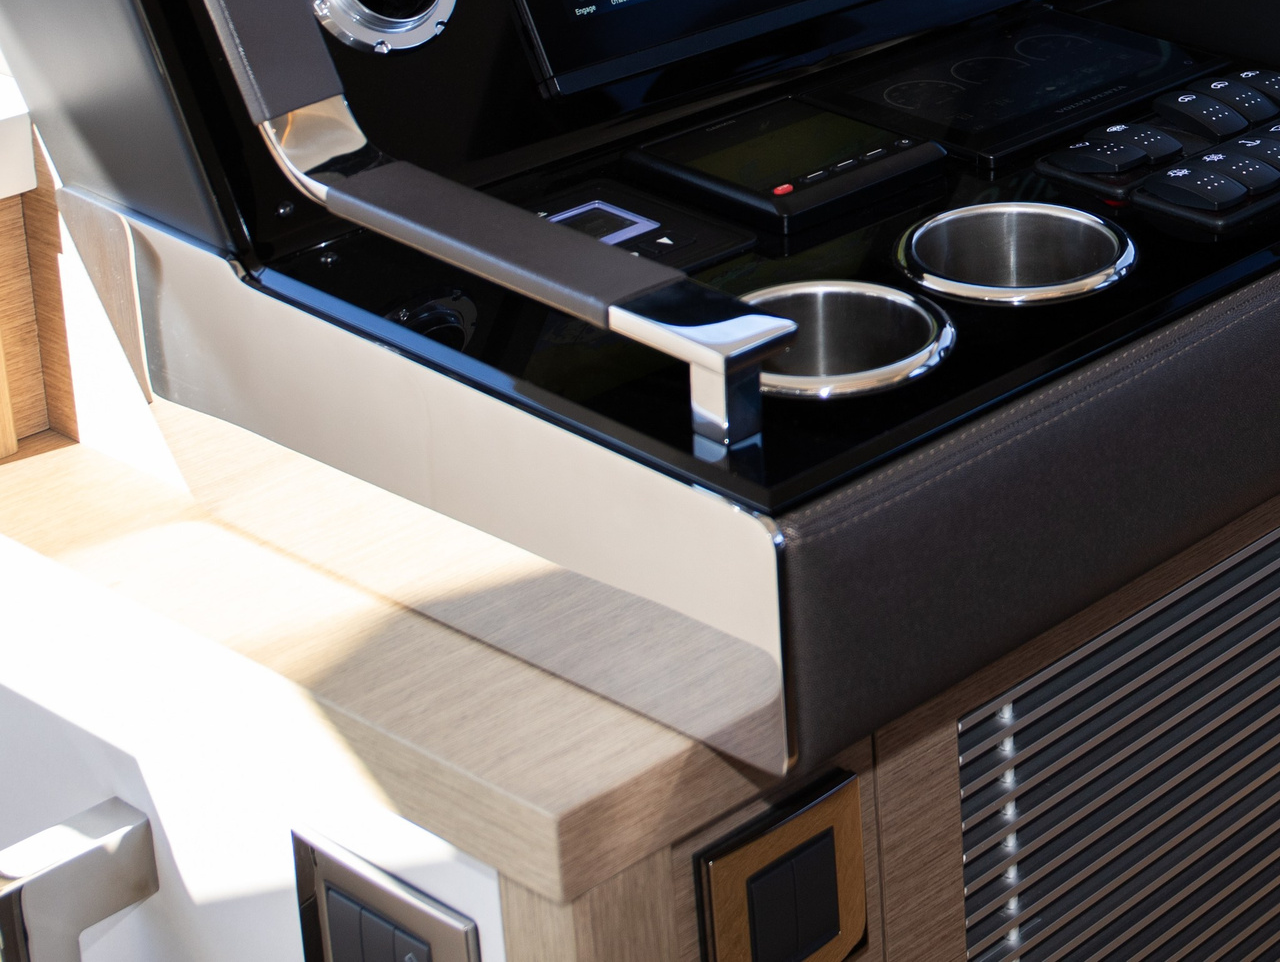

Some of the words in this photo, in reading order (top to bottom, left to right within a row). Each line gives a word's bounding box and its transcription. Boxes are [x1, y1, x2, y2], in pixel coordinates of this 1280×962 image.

[574, 4, 596, 16] Engage
[1054, 98, 1091, 113] VOLVO
[1090, 85, 1128, 101] PENTA
